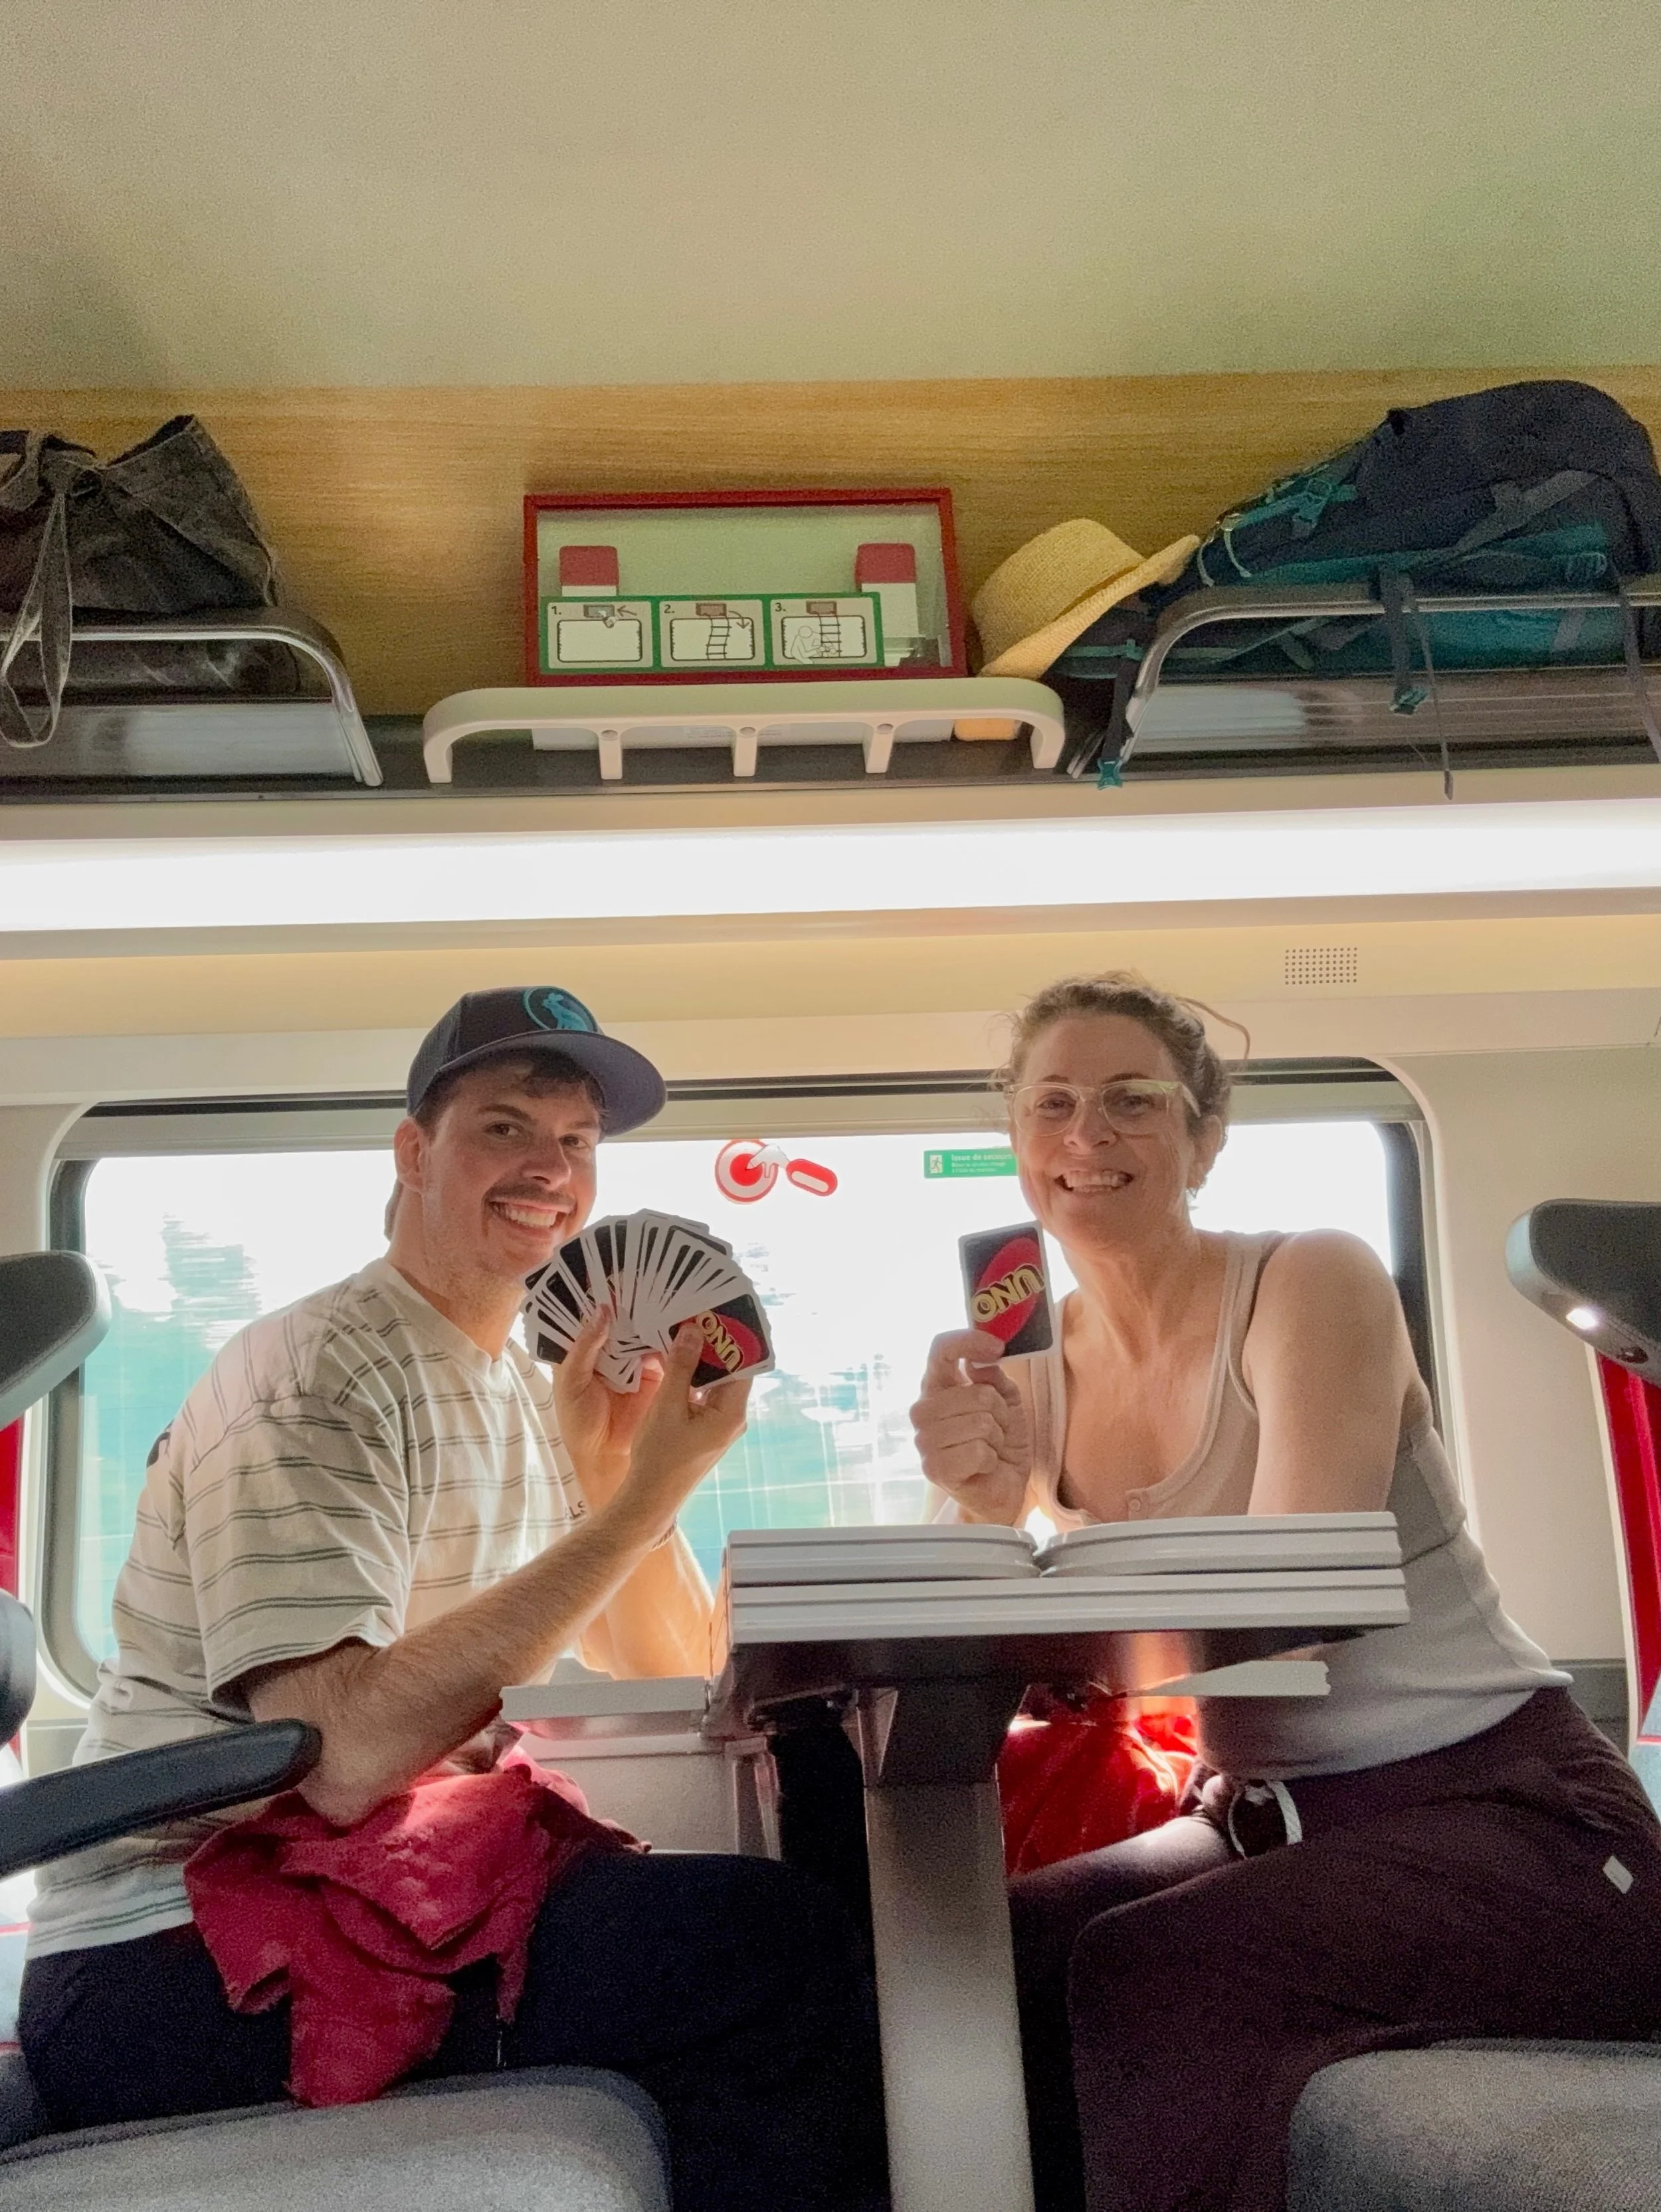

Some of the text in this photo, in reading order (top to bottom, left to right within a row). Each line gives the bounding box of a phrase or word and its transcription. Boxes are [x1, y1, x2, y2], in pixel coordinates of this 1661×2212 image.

[551, 605, 562, 615] 1.
[664, 604, 675, 614] 2.
[775, 602, 787, 612] 3.
[970, 1263, 1045, 1323] UNO
[696, 1310, 743, 1374] UNO
